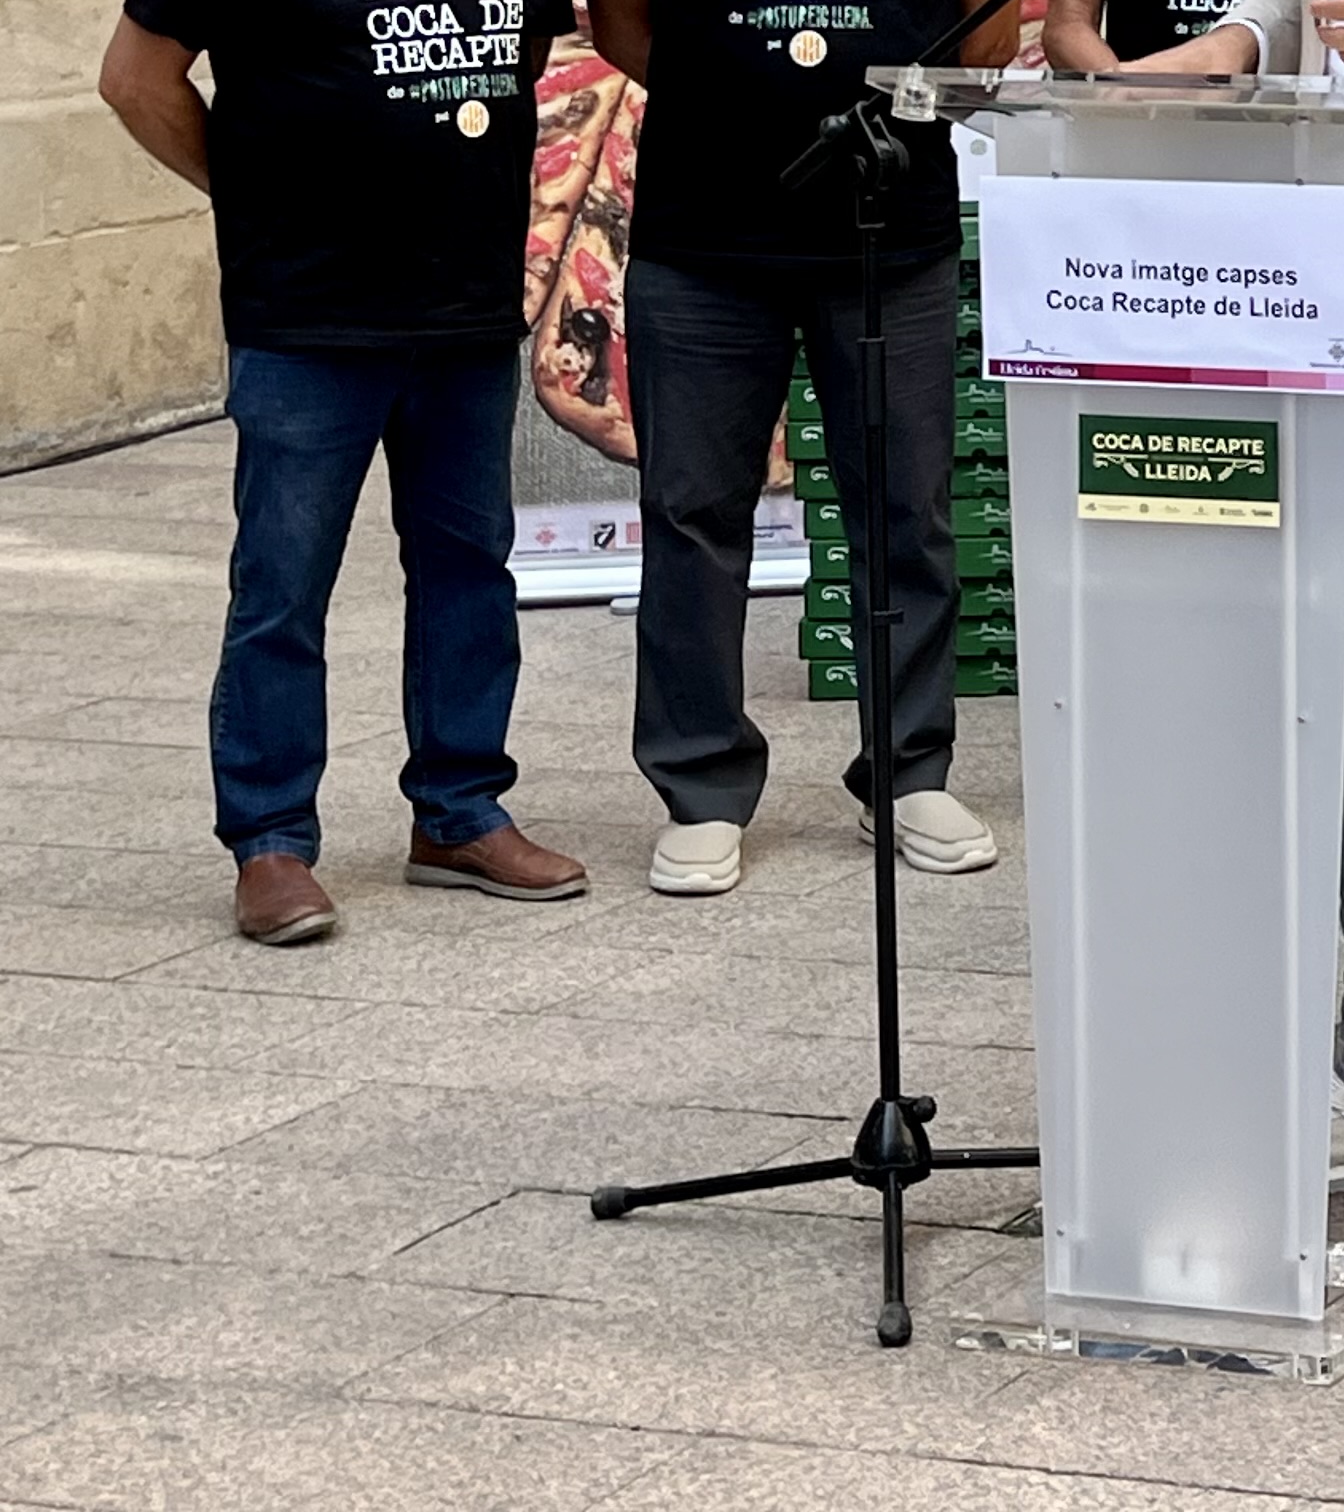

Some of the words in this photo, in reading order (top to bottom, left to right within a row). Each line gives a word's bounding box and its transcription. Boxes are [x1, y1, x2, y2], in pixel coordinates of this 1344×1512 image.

[367, 3, 465, 40] COCA
[371, 33, 520, 75] RECAPTE
[1065, 258, 1124, 280] Nova
[1131, 260, 1209, 287] imatge
[1216, 265, 1298, 289] capses
[1046, 290, 1104, 312] Coca
[1112, 292, 1206, 319] Recapte
[1214, 295, 1241, 317] de
[1250, 297, 1319, 320] Lleida
[1092, 433, 1145, 451] COCA
[1148, 435, 1174, 452] DE
[1177, 436, 1265, 455] RECAPTE
[1145, 463, 1212, 482] LLEIDA
